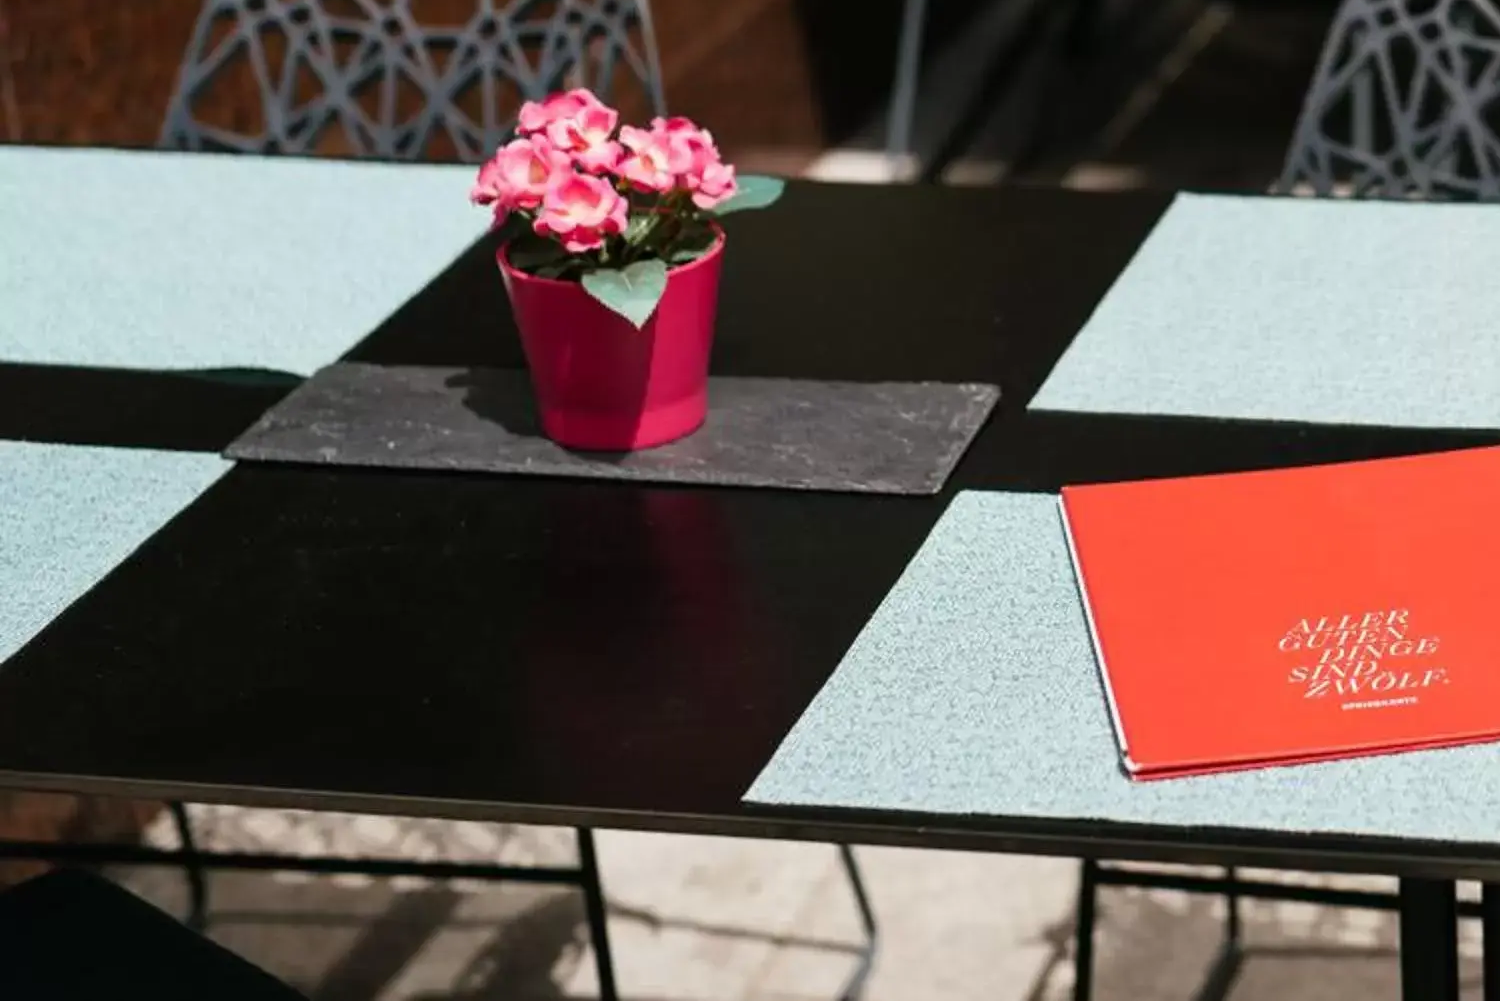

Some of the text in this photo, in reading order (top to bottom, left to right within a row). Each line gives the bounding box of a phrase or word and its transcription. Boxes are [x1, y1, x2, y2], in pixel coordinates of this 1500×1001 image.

[1288, 609, 1409, 634] ALLER
[1279, 626, 1408, 652] GUTEN
[1320, 637, 1441, 664] DINGE
[1288, 660, 1378, 683] SIND
